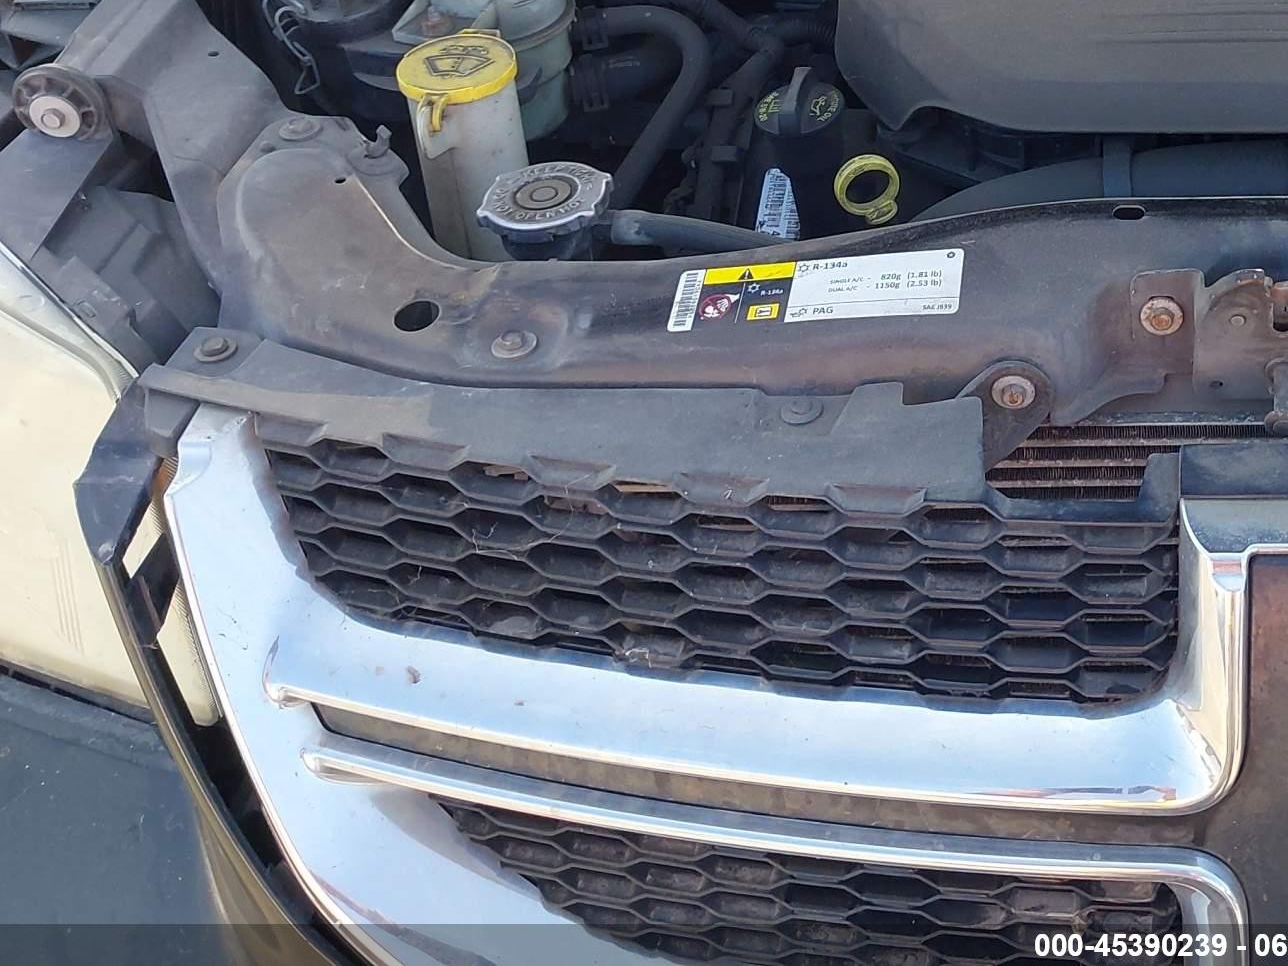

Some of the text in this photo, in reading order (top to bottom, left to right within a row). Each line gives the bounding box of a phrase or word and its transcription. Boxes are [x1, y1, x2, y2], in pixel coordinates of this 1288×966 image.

[522, 166, 564, 178] KEEP
[515, 211, 558, 221] OPEN
[812, 261, 848, 270] R-134a
[880, 272, 902, 282] 820g
[906, 270, 928, 279] (1.81
[930, 270, 942, 278] lb)
[875, 281, 900, 290] 1150g
[906, 279, 928, 288] (2.53
[930, 278, 942, 287] lb)
[812, 306, 834, 315] PAG
